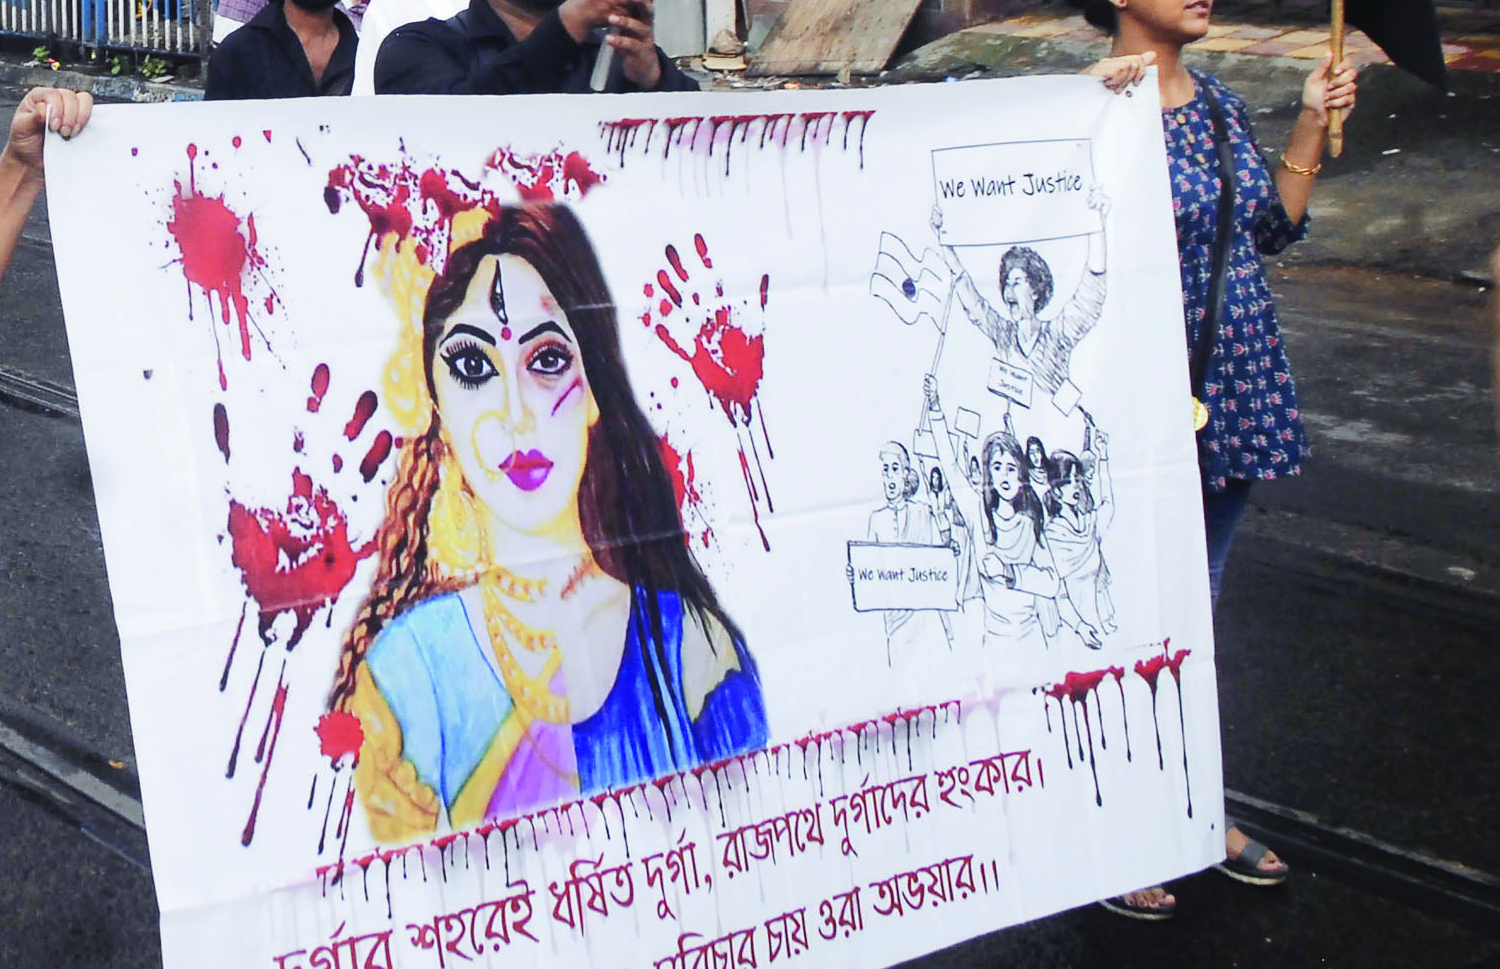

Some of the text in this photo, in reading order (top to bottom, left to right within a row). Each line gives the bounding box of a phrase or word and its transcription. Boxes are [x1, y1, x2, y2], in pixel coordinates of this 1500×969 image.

[940, 169, 1082, 199] We Want Justice
[858, 567, 948, 582] We Want Justice
[406, 879, 540, 968] শহরেই
[548, 853, 634, 936] ধর্ষিত
[642, 827, 712, 919] দুর্গা,
[716, 803, 824, 879] রাজপথে
[830, 773, 930, 857] দুর্গাদের
[764, 907, 809, 963] চায়
[818, 887, 864, 939] ওরা
